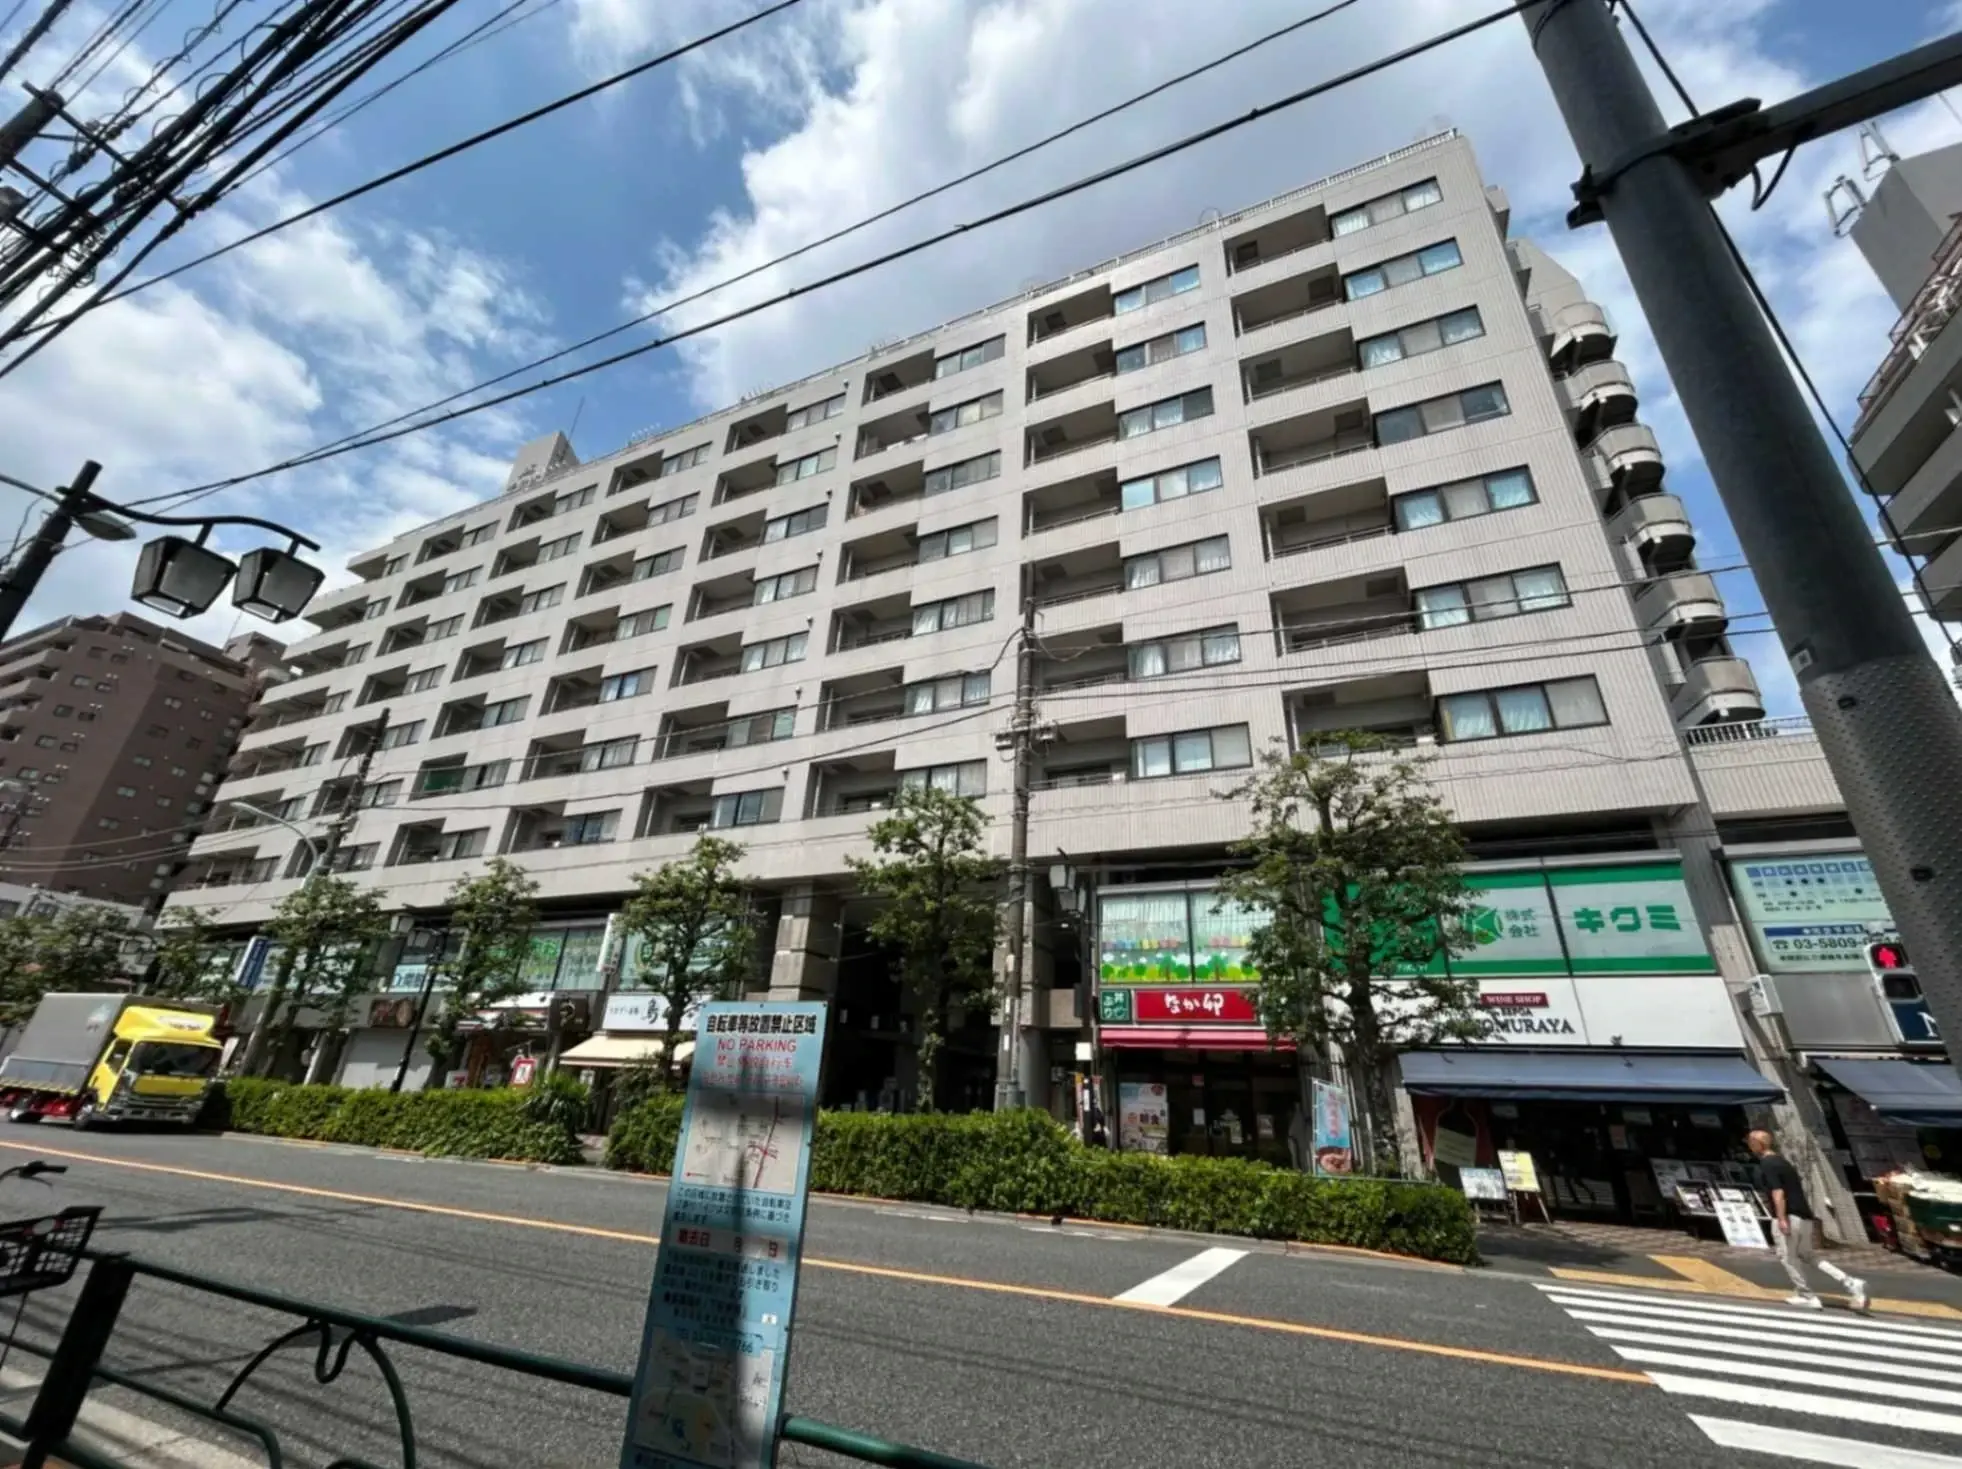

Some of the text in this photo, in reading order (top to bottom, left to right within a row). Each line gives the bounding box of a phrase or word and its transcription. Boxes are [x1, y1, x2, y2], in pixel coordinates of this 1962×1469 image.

[1504, 908, 1535, 922] 株式
[1573, 904, 1682, 934] キクミ
[1507, 924, 1540, 938] 会社
[1164, 992, 1224, 1016] なか卯
[1486, 995, 1542, 1004] WINE SHOP
[706, 1014, 817, 1034] 自転車等放置禁止区域
[718, 1039, 797, 1053] NO PARKING
